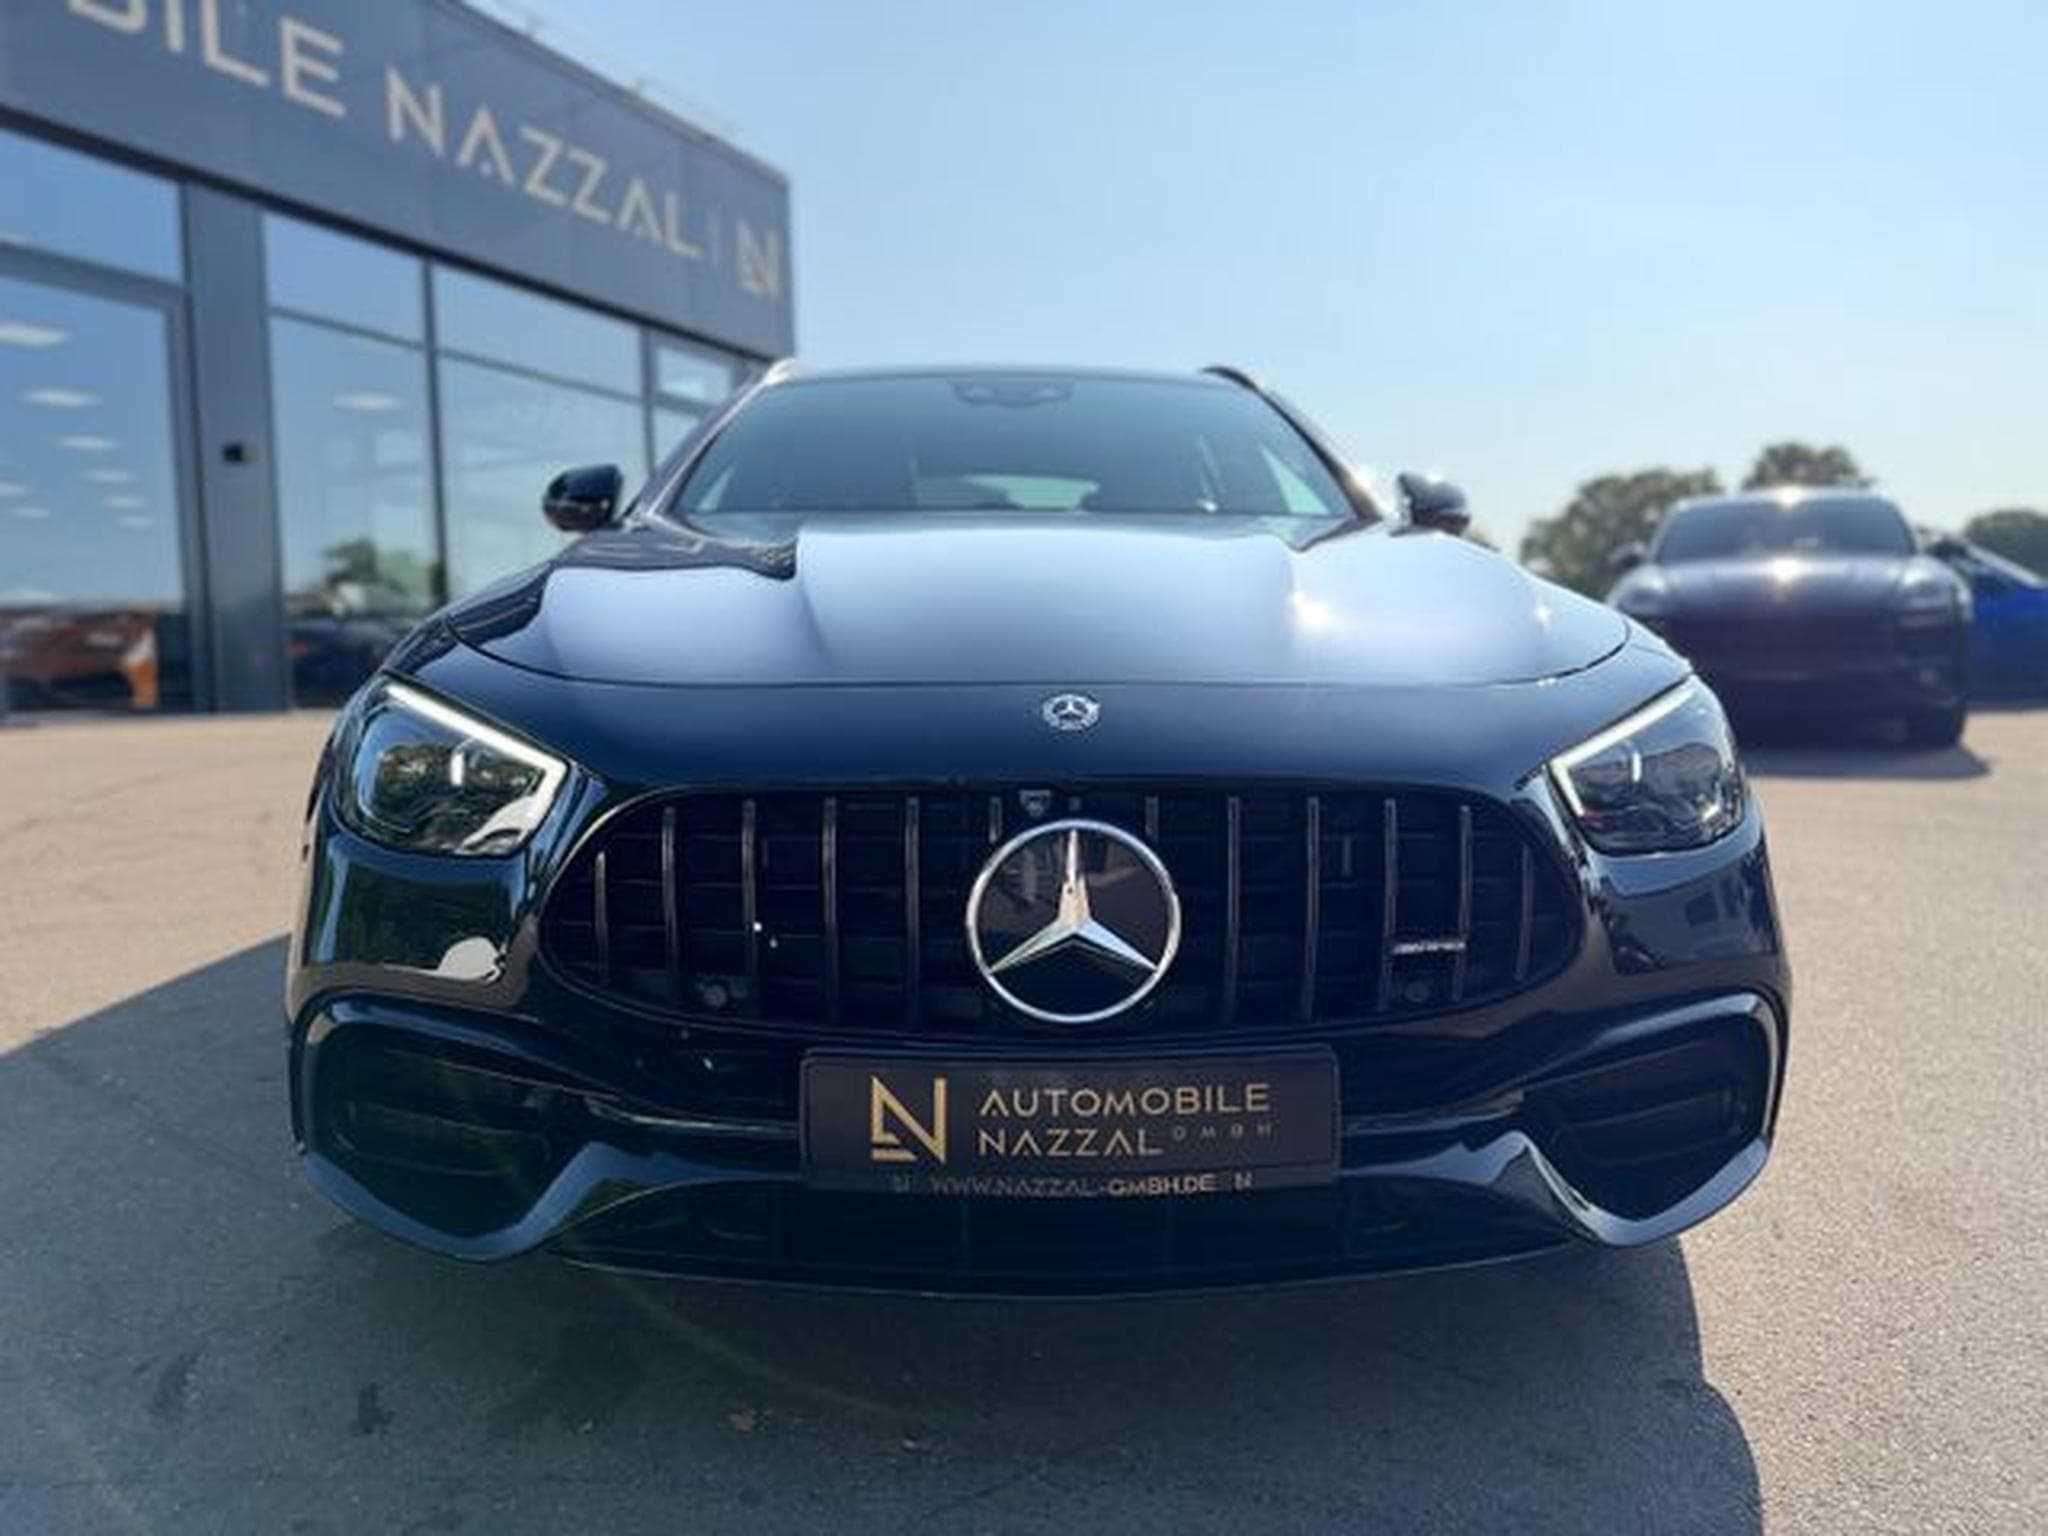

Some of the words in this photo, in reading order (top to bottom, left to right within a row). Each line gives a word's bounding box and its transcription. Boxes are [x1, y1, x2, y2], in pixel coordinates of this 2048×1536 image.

[67, 0, 346, 118] ILE
[385, 65, 701, 259] NAZZAL
[979, 1083, 1272, 1117] AUTOMOBILE
[978, 1128, 1164, 1157] NAZZAL
